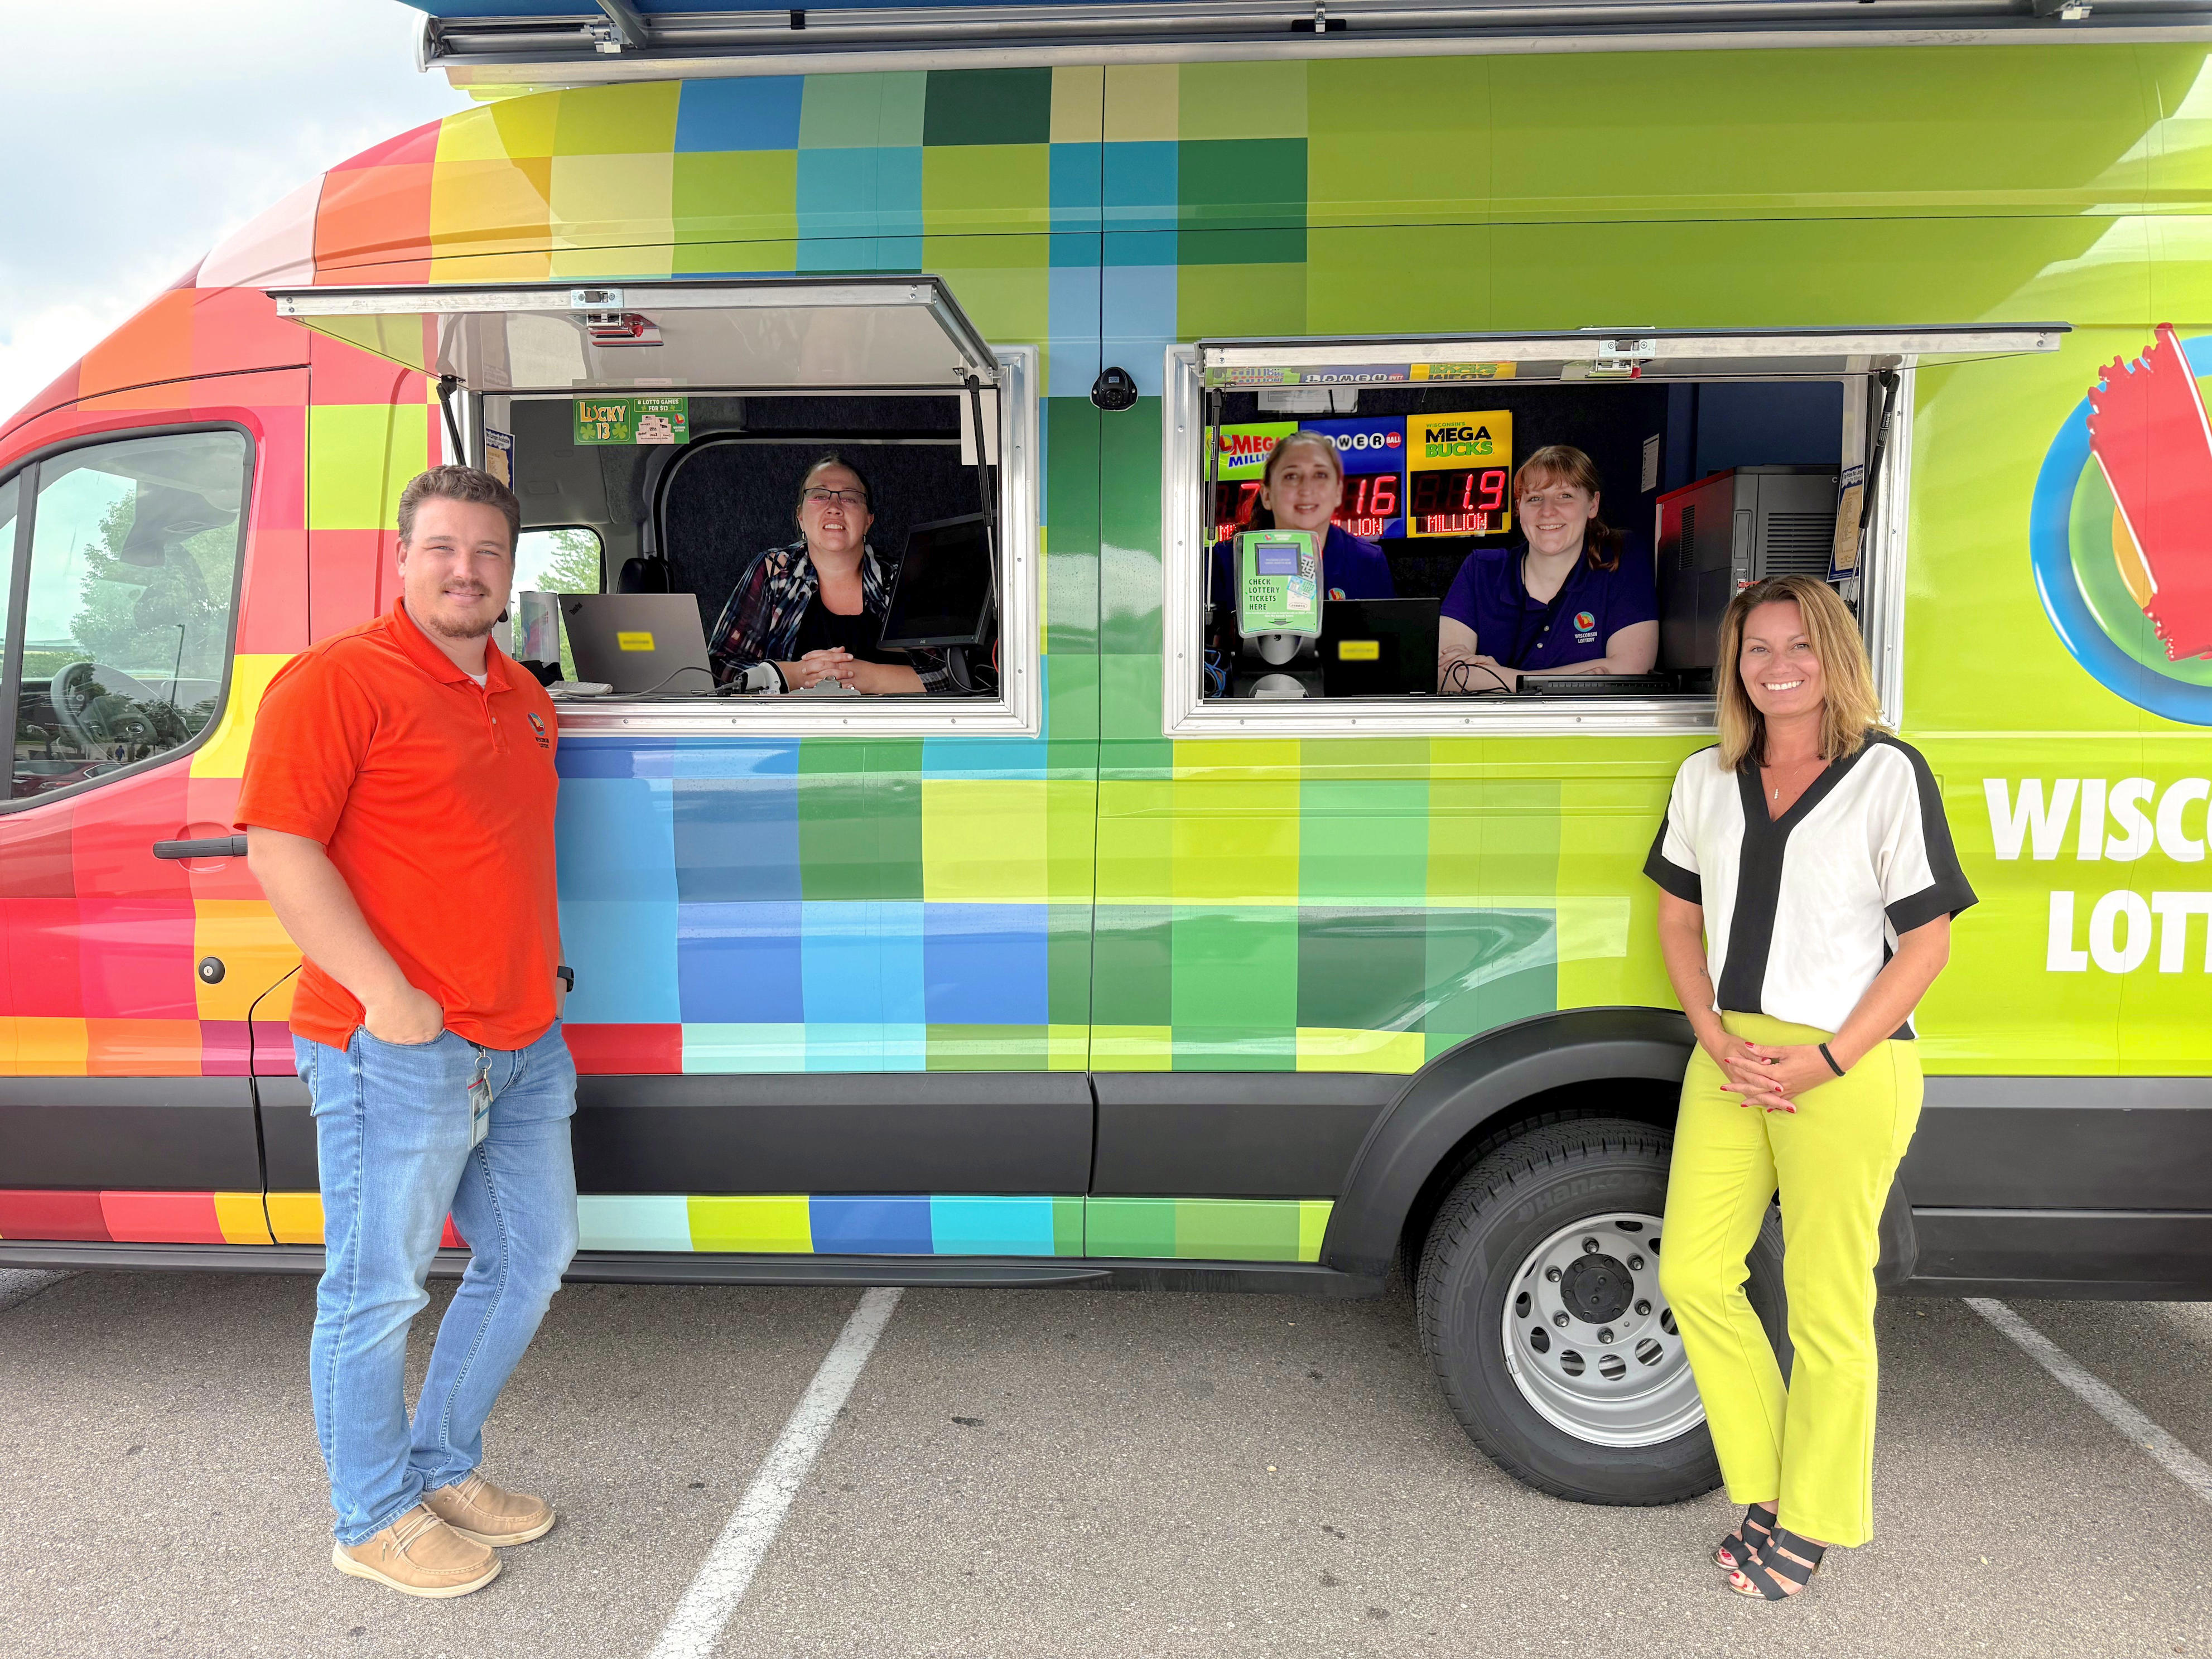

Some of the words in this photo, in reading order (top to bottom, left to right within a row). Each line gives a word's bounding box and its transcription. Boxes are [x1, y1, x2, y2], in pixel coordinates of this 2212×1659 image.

[580, 401, 626, 422] LUCKY
[596, 422, 610, 439] 13
[1426, 426, 1492, 443] MEGA
[1426, 441, 1493, 457] BUCKS
[1357, 476, 1396, 514] 16
[1463, 470, 1505, 510] 1.9
[1427, 512, 1487, 533] MILLION
[1983, 778, 2212, 862] WISC
